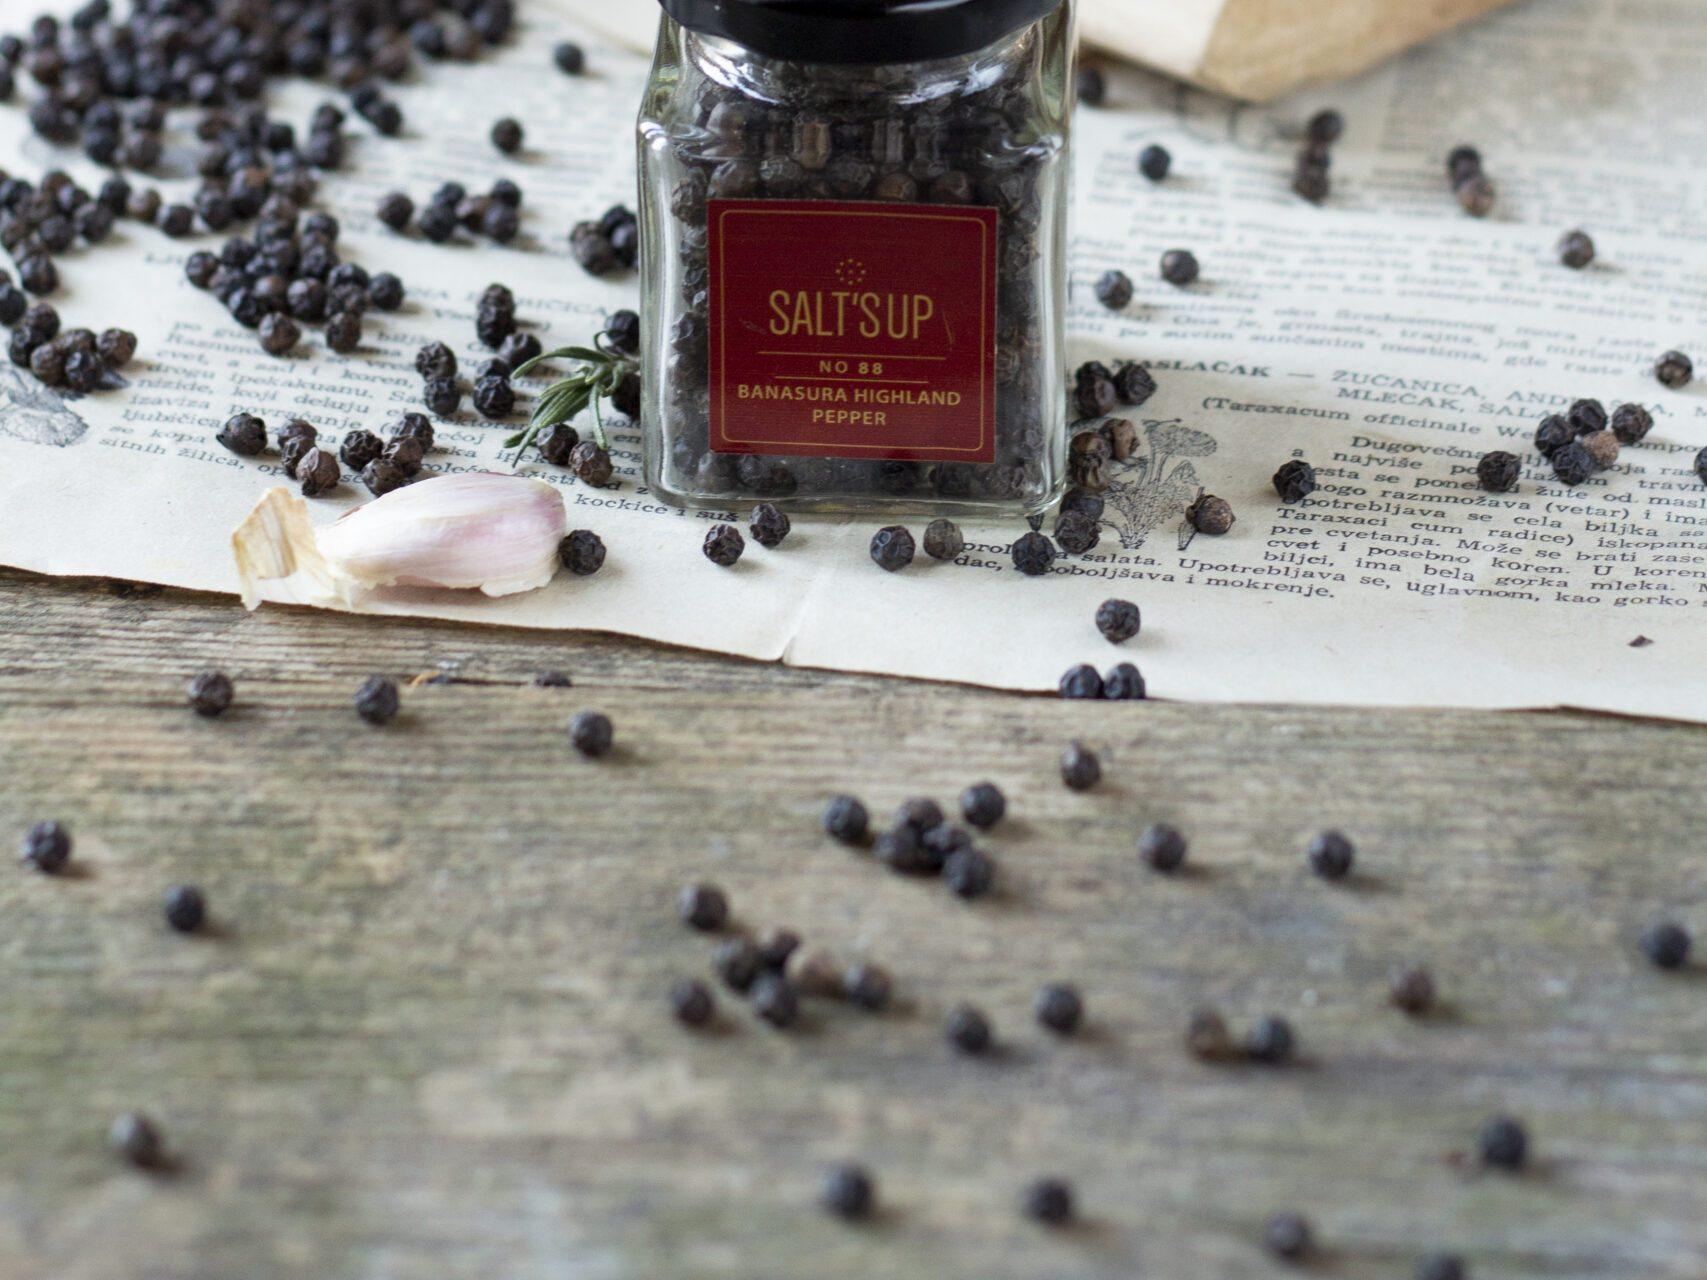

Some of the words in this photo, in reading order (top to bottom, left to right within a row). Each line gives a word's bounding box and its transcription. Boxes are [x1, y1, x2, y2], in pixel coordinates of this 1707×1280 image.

[819, 361, 848, 374] NO
[859, 362, 884, 375] 88
[738, 385, 847, 402] BANASURA
[854, 388, 961, 406] HIGHLAND
[812, 409, 887, 426] PEPPER
[1202, 397, 1350, 421] (Taraxacum
[1364, 413, 1481, 434] officinale
[1332, 451, 1423, 469] najviše
[1638, 480, 1706, 492] travn
[574, 493, 669, 515] kockice
[1374, 473, 1400, 484] se
[1536, 485, 1588, 501] žute
[1649, 496, 1707, 510] masl
[1380, 488, 1531, 511] razmnožava
[1545, 501, 1629, 520] (vetar)
[1644, 509, 1652, 520] i
[1277, 507, 1388, 527] Taraxaci
[1411, 521, 1463, 535] cum
[1488, 529, 1574, 547] radice)
[1467, 511, 1493, 522] se
[1514, 516, 1562, 529] cela
[1585, 520, 1659, 537] biljka
[1266, 539, 1320, 551] cvet
[1339, 541, 1348, 552] i
[1368, 546, 1471, 564] posebno
[1491, 556, 1572, 575] koren.
[1594, 564, 1614, 577] U
[1634, 565, 1707, 579] koren
[1270, 524, 1313, 536] pre
[1326, 528, 1440, 547] cvetanja.
[1457, 539, 1523, 555] Može
[1535, 549, 1562, 560] se
[1576, 551, 1637, 563] brati
[1652, 553, 1706, 565] zase
[953, 555, 1003, 572] dac,
[1185, 574, 1195, 585] i
[1206, 576, 1335, 600] mokrenje.
[1081, 552, 1162, 567] salata.
[1178, 557, 1346, 582] Upotrebljava
[1360, 575, 1391, 590] se,
[1406, 580, 1540, 603] uglavnom,
[1555, 591, 1601, 604] kao
[1613, 594, 1689, 608] gorko
[1264, 550, 1333, 568] biljci,
[1356, 557, 1402, 572] ima
[1424, 563, 1475, 582] bela
[1495, 575, 1569, 589] gorka
[1591, 579, 1676, 592] mleka.
